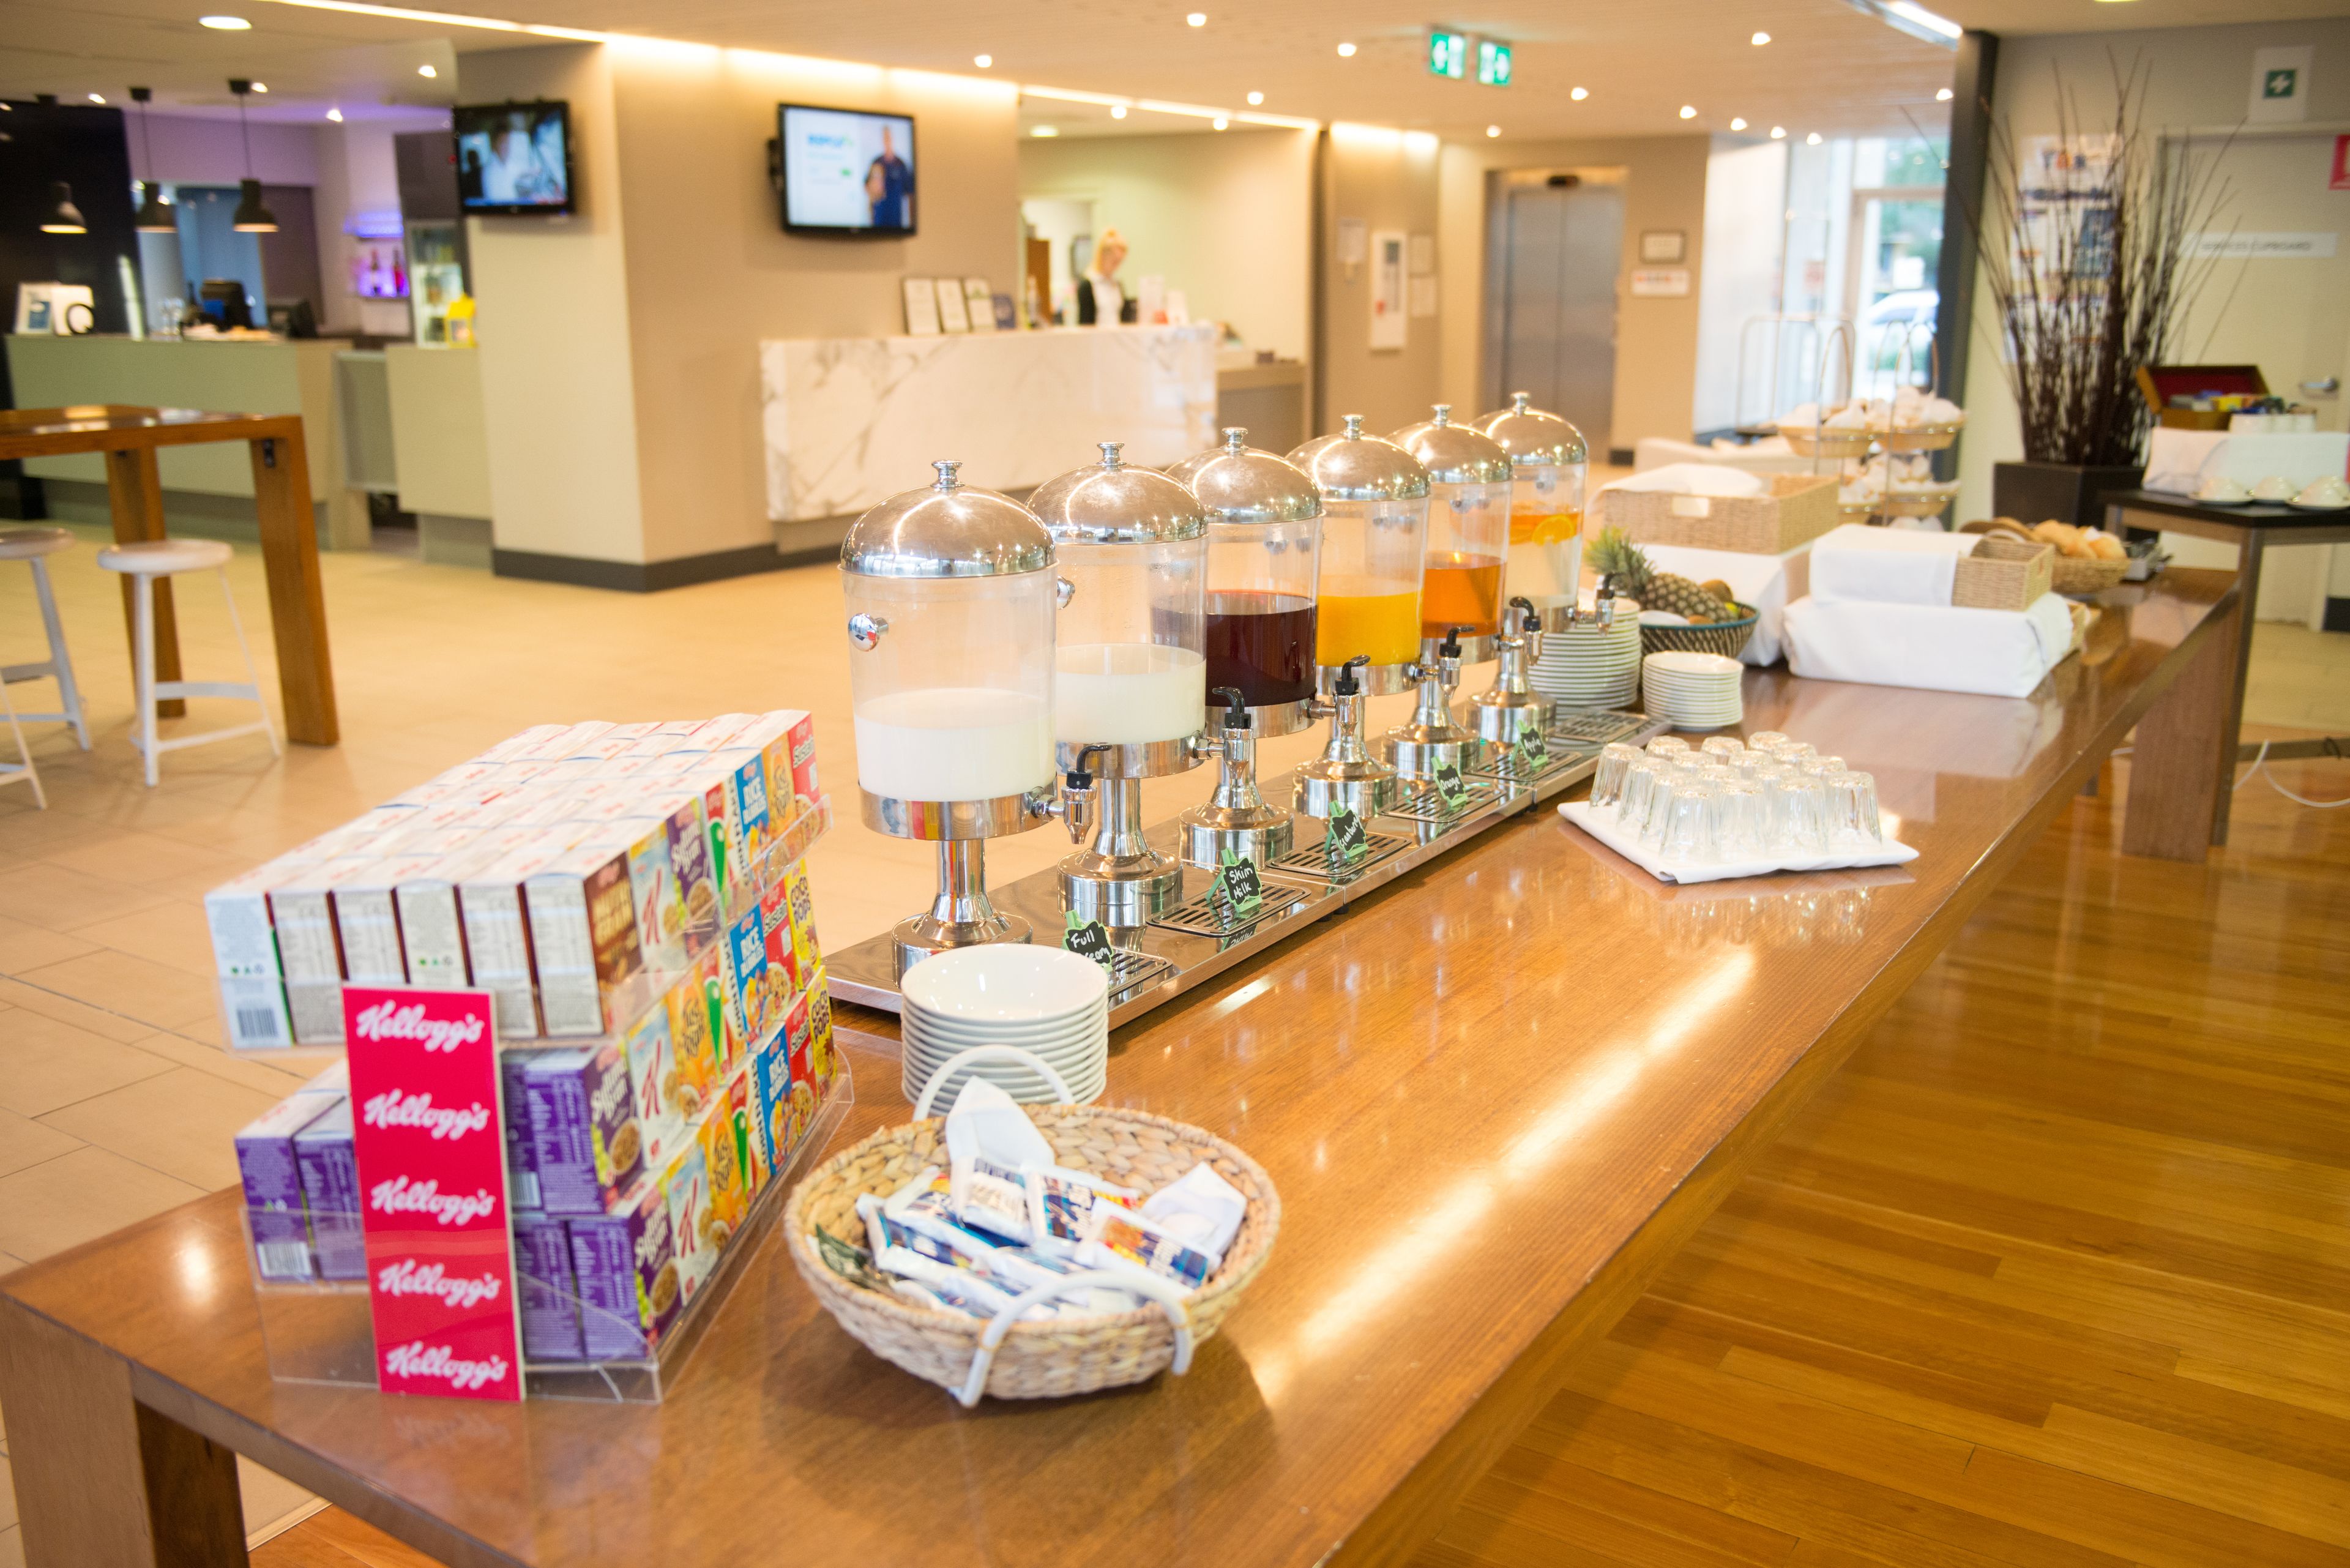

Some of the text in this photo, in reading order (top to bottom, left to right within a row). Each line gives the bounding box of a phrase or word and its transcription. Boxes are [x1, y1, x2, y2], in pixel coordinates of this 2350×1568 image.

[1524, 737, 1542, 752] Apple
[1440, 777, 1460, 791] Orange
[1339, 816, 1359, 848] Cranberry
[1229, 865, 1253, 884] Skim
[1233, 881, 1252, 900] Milk
[1070, 929, 1095, 949] Full
[356, 999, 485, 1052] Kellogg's
[363, 1088, 491, 1140] Kellogg's
[370, 1175, 496, 1225] Kellogg's
[378, 1259, 502, 1309] Kellogg's
[385, 1340, 510, 1389] Kellogg's
